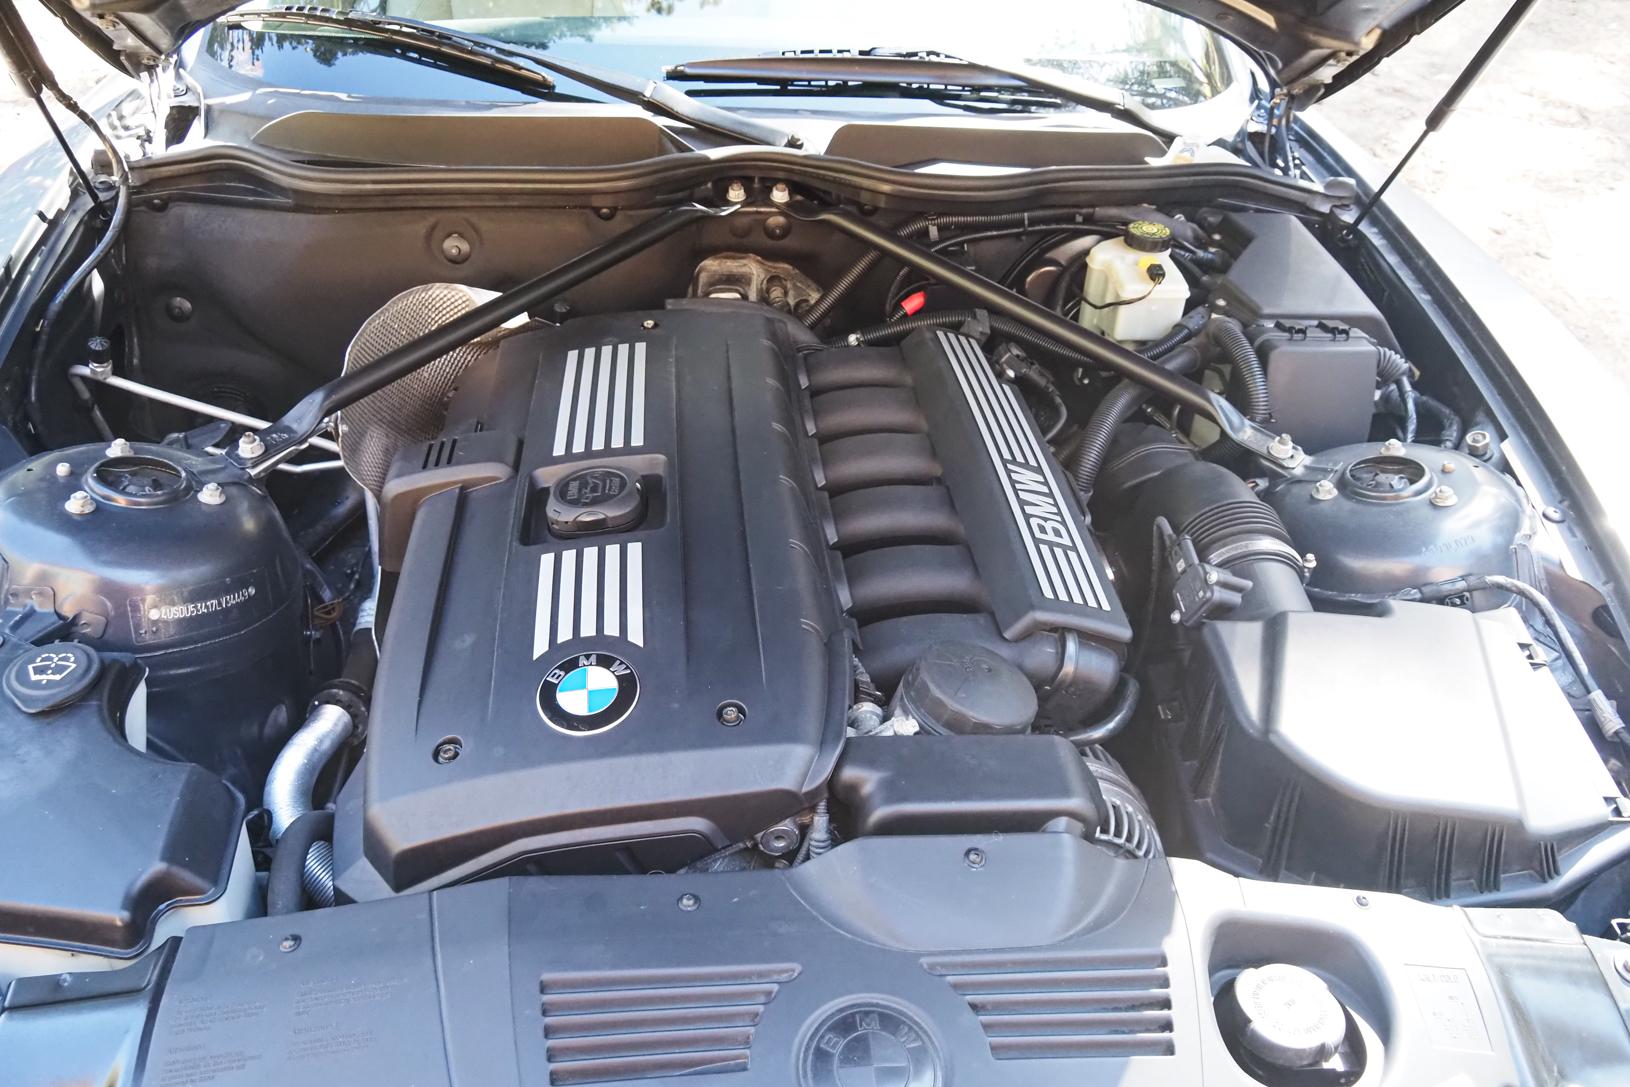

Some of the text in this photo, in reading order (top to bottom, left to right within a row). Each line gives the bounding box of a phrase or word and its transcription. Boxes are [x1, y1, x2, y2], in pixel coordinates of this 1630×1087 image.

[1006, 463, 1073, 547] BMW
[546, 654, 631, 684] BMW
[819, 1013, 923, 1054] BMW
